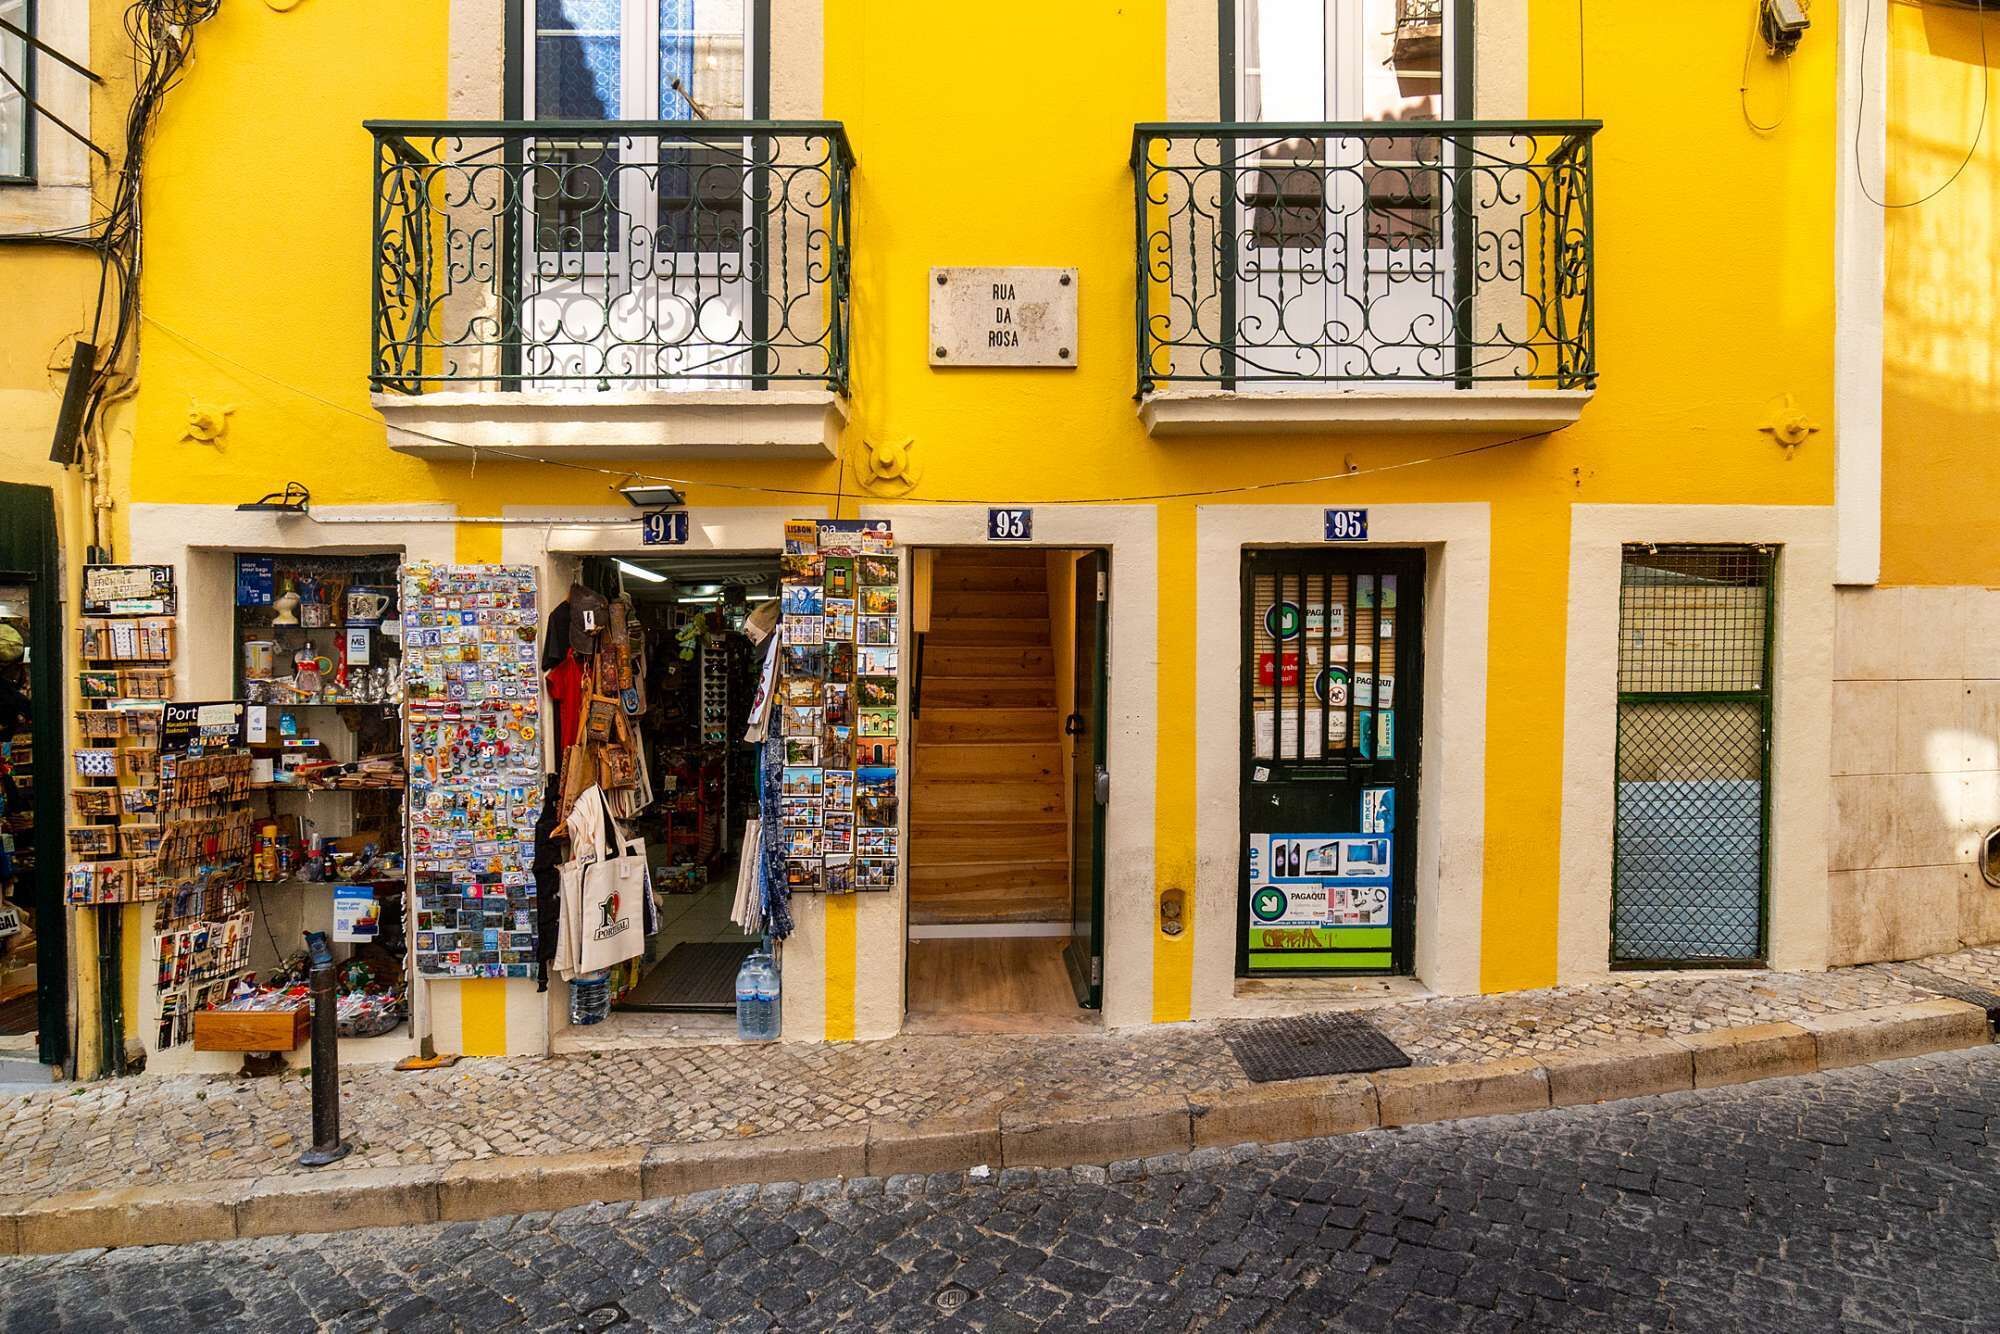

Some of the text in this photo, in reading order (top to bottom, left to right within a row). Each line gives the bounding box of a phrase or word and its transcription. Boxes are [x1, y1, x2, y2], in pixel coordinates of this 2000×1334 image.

[992, 283, 1016, 301] RUA
[996, 307, 1012, 324] DA
[988, 330, 1019, 348] ROSA
[651, 514, 679, 542] 91
[787, 525, 812, 533] LISBON
[996, 511, 1024, 537] 93
[1334, 511, 1361, 538] 95
[351, 638, 366, 646] MB
[1290, 892, 1327, 901] PAGAQUI
